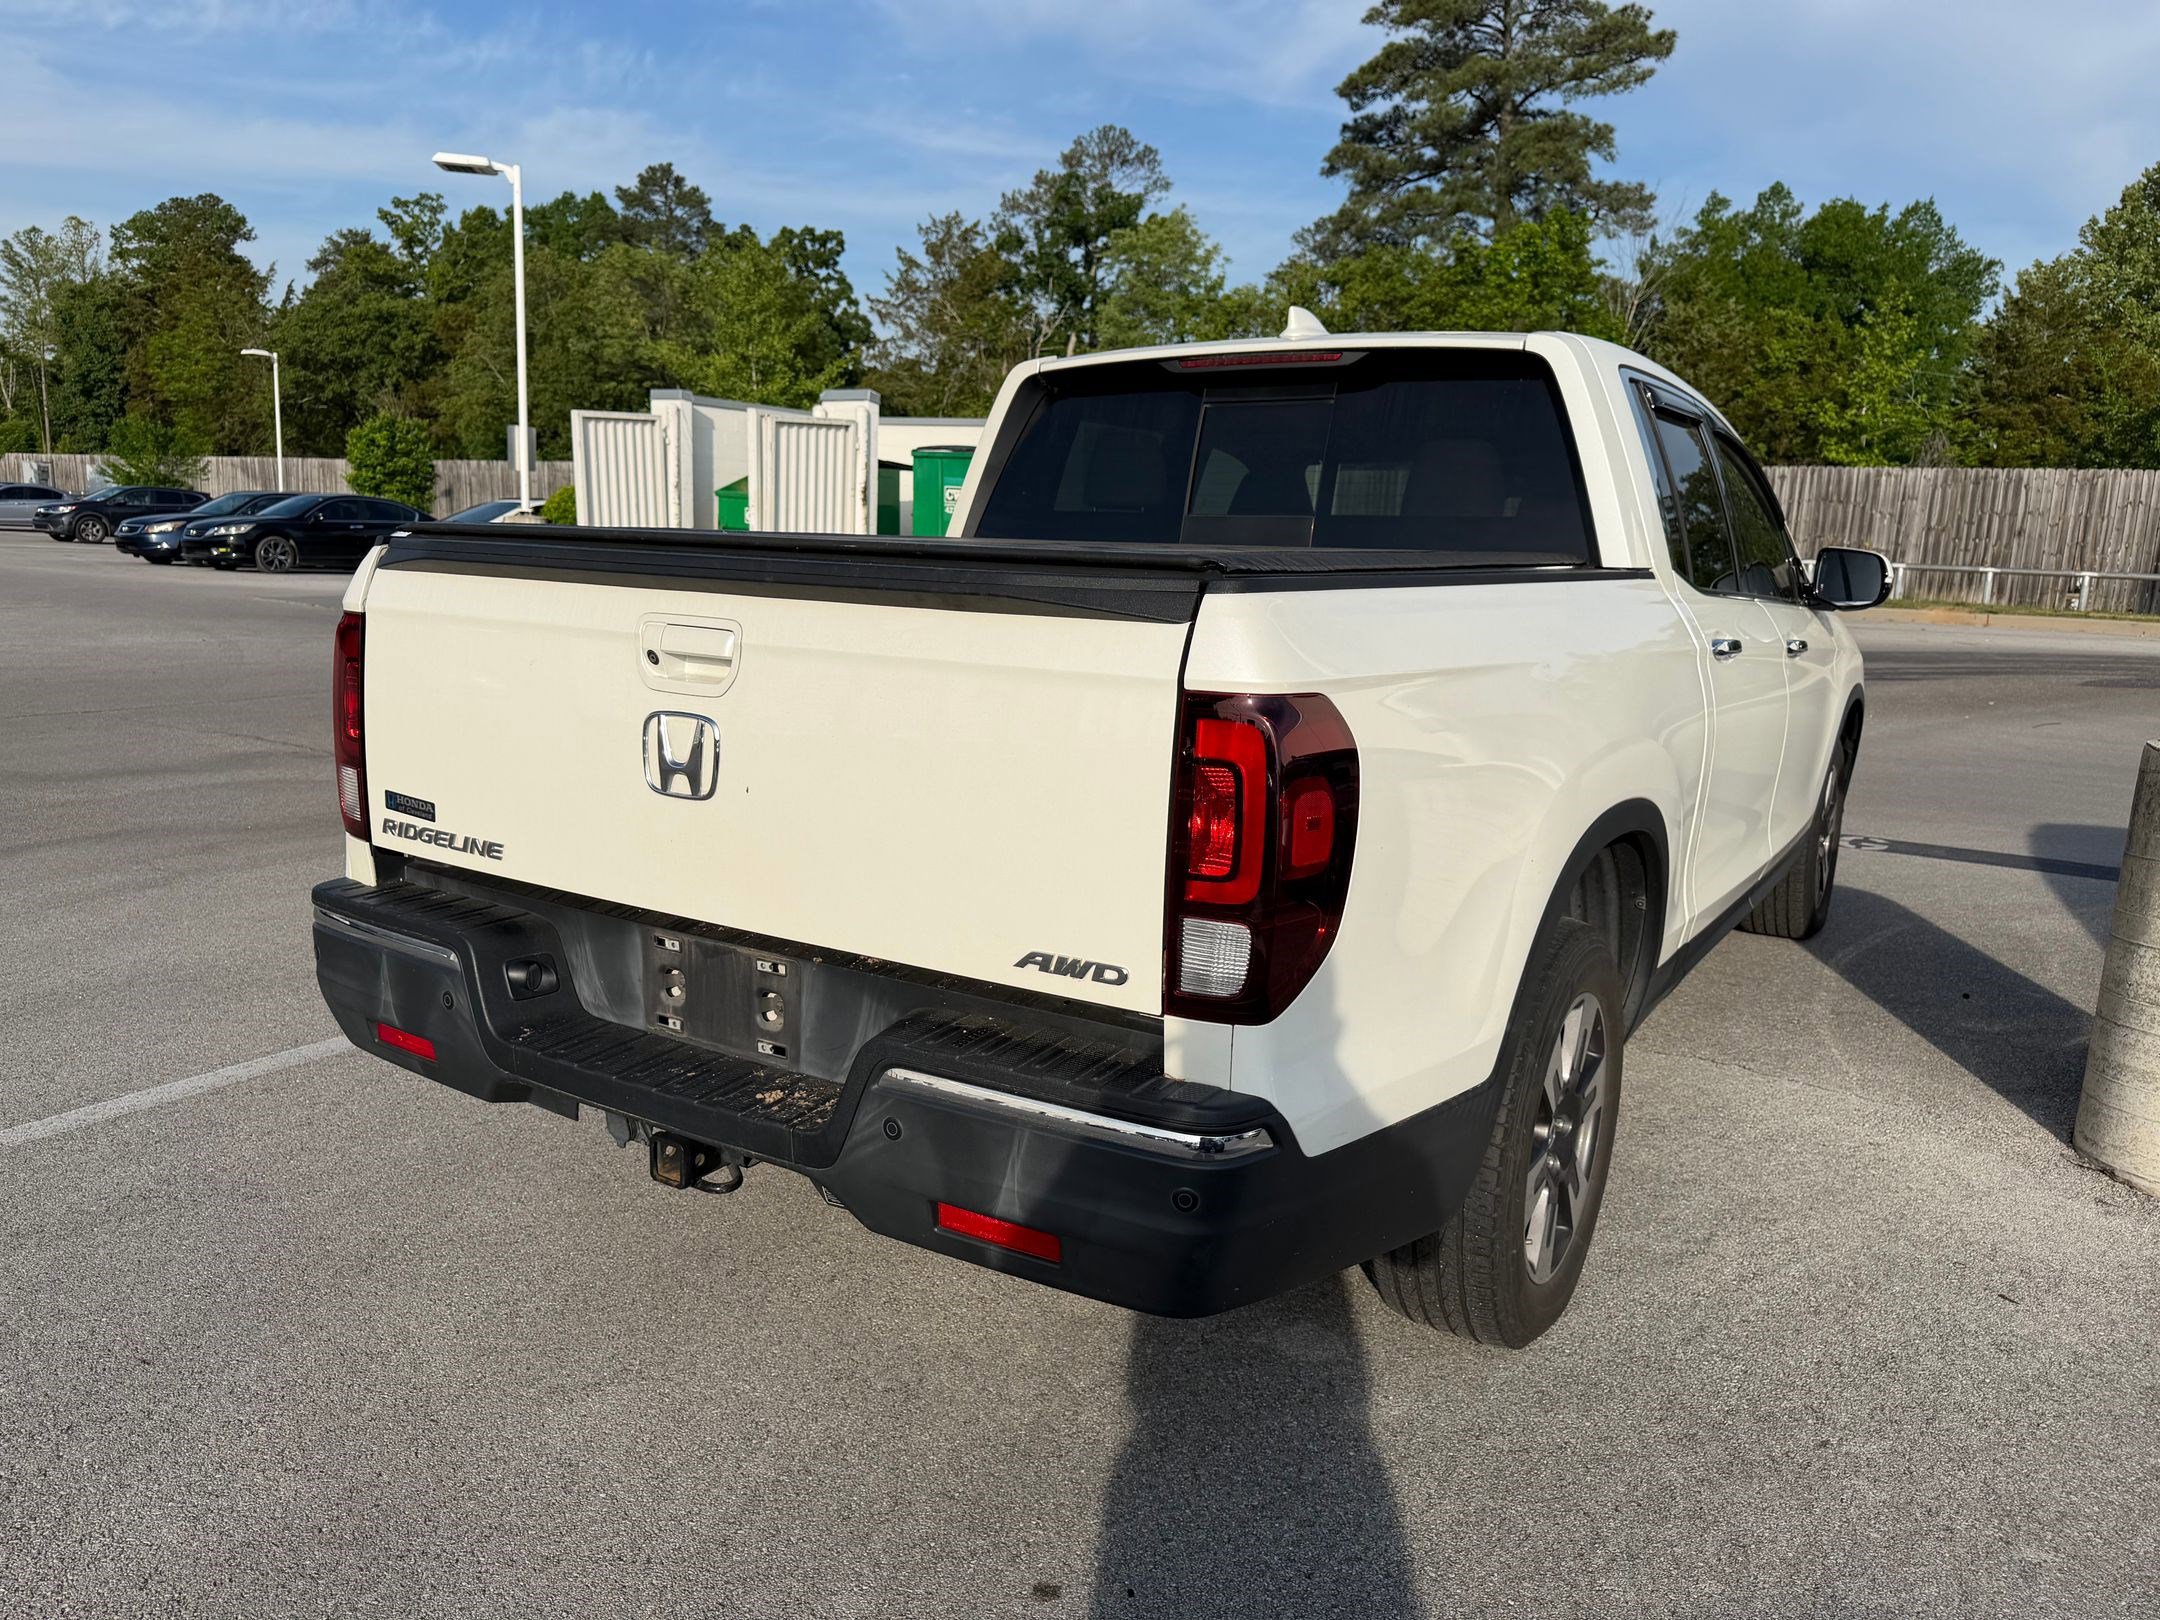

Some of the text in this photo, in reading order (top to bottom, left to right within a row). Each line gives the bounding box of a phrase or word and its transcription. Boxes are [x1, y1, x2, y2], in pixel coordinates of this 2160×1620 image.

[396, 794, 434, 812] HONDA
[382, 818, 504, 860] RIDGELINE
[1013, 951, 1128, 986] AWD
